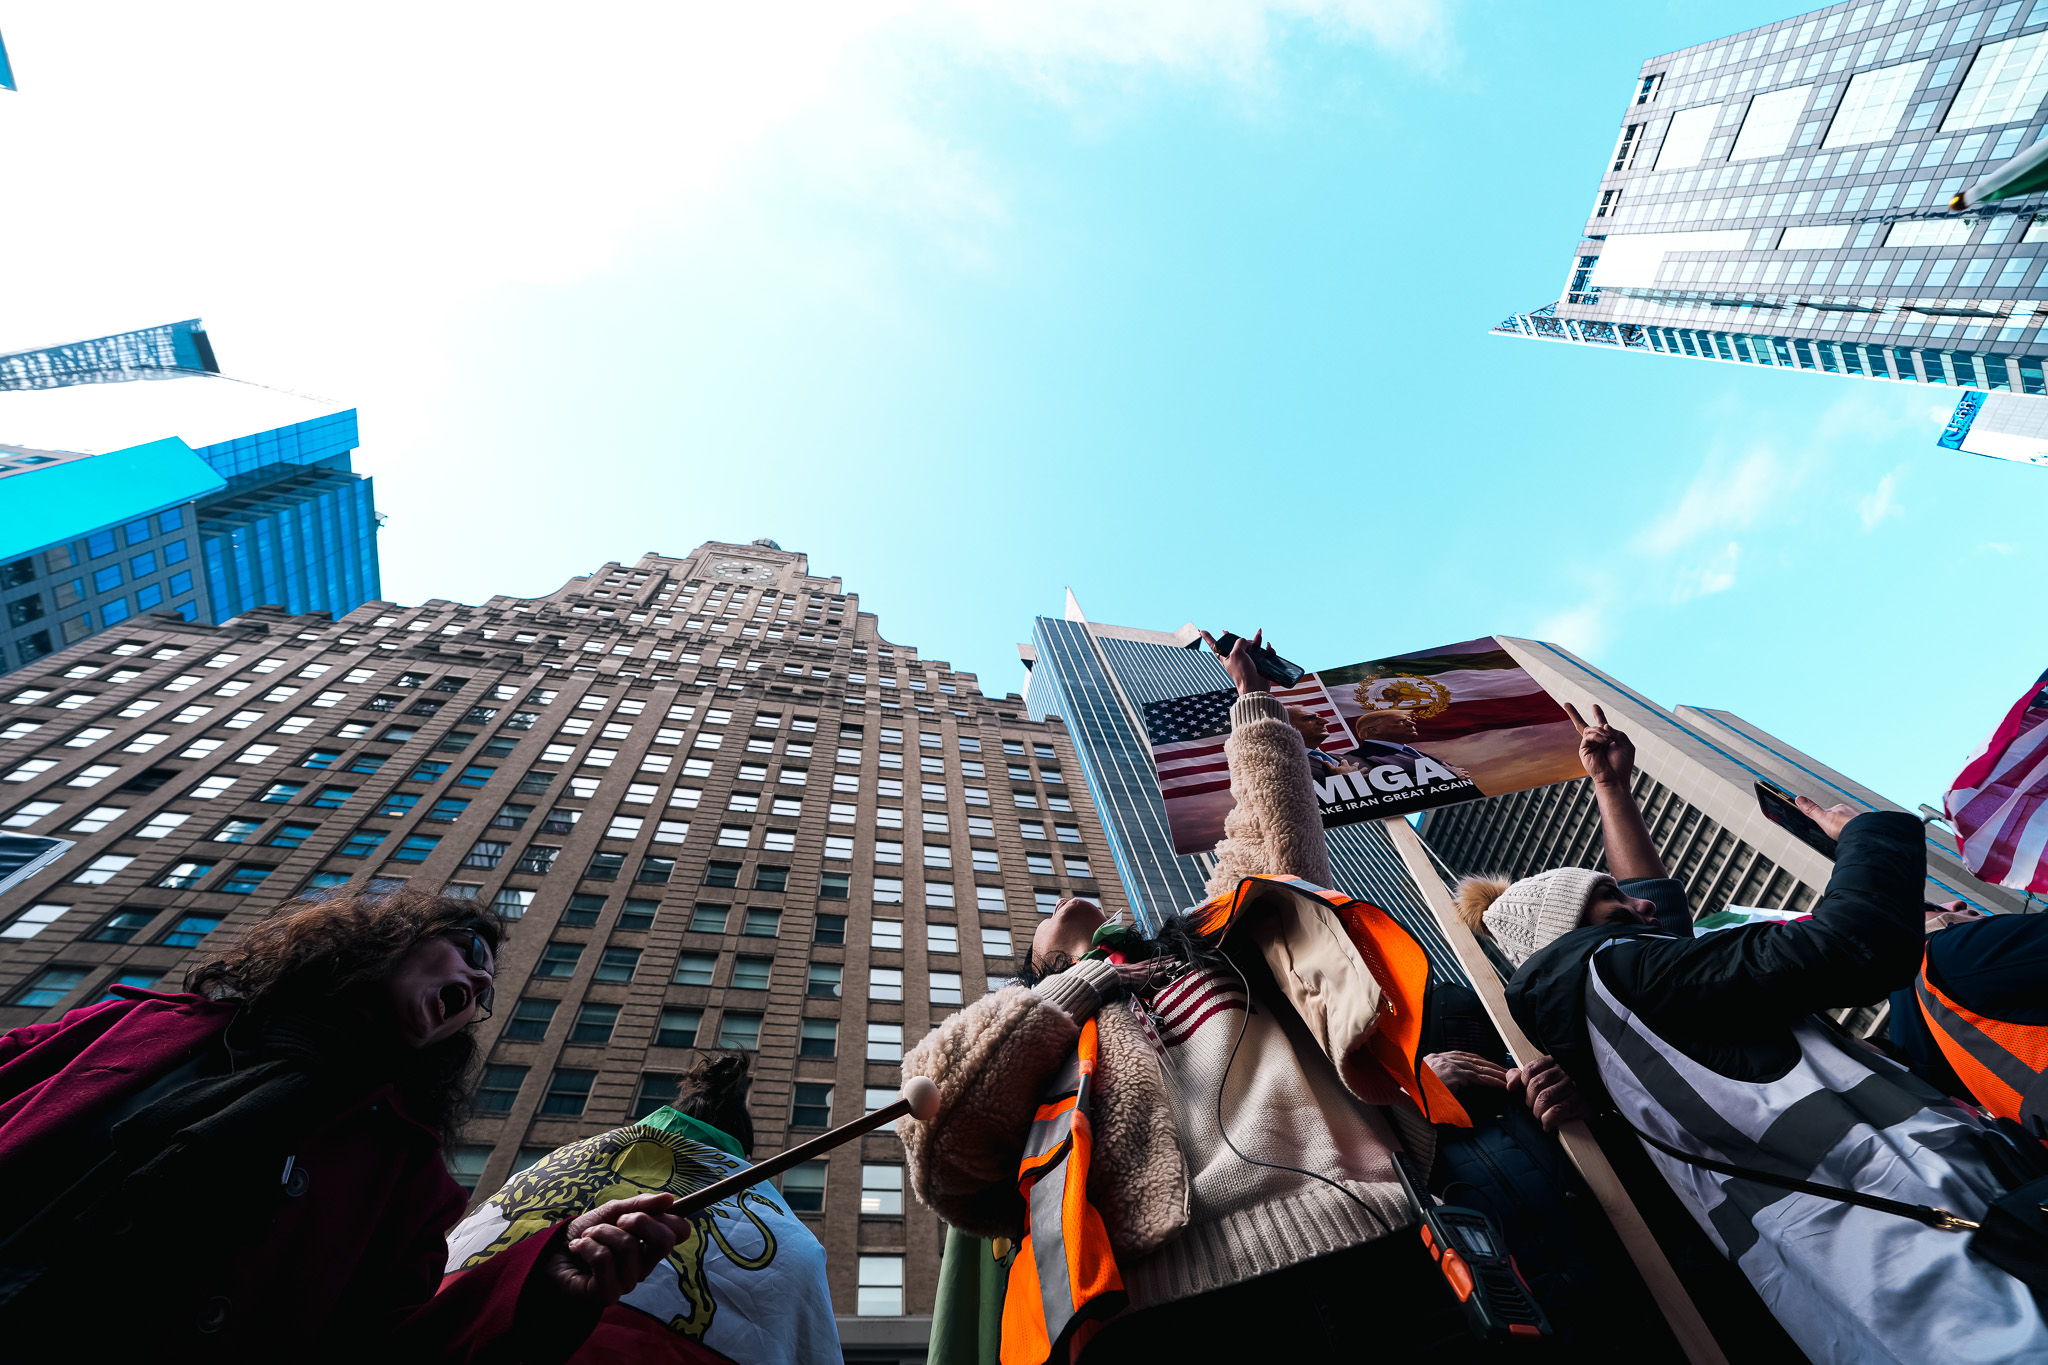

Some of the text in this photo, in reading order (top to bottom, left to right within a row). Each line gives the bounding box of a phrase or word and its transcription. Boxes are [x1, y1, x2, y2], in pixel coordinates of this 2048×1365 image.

[1946, 400, 1973, 433] 1568
[1312, 756, 1457, 805] MIGA
[1318, 778, 1474, 815] AKE IRAN GREAT AGAIN
